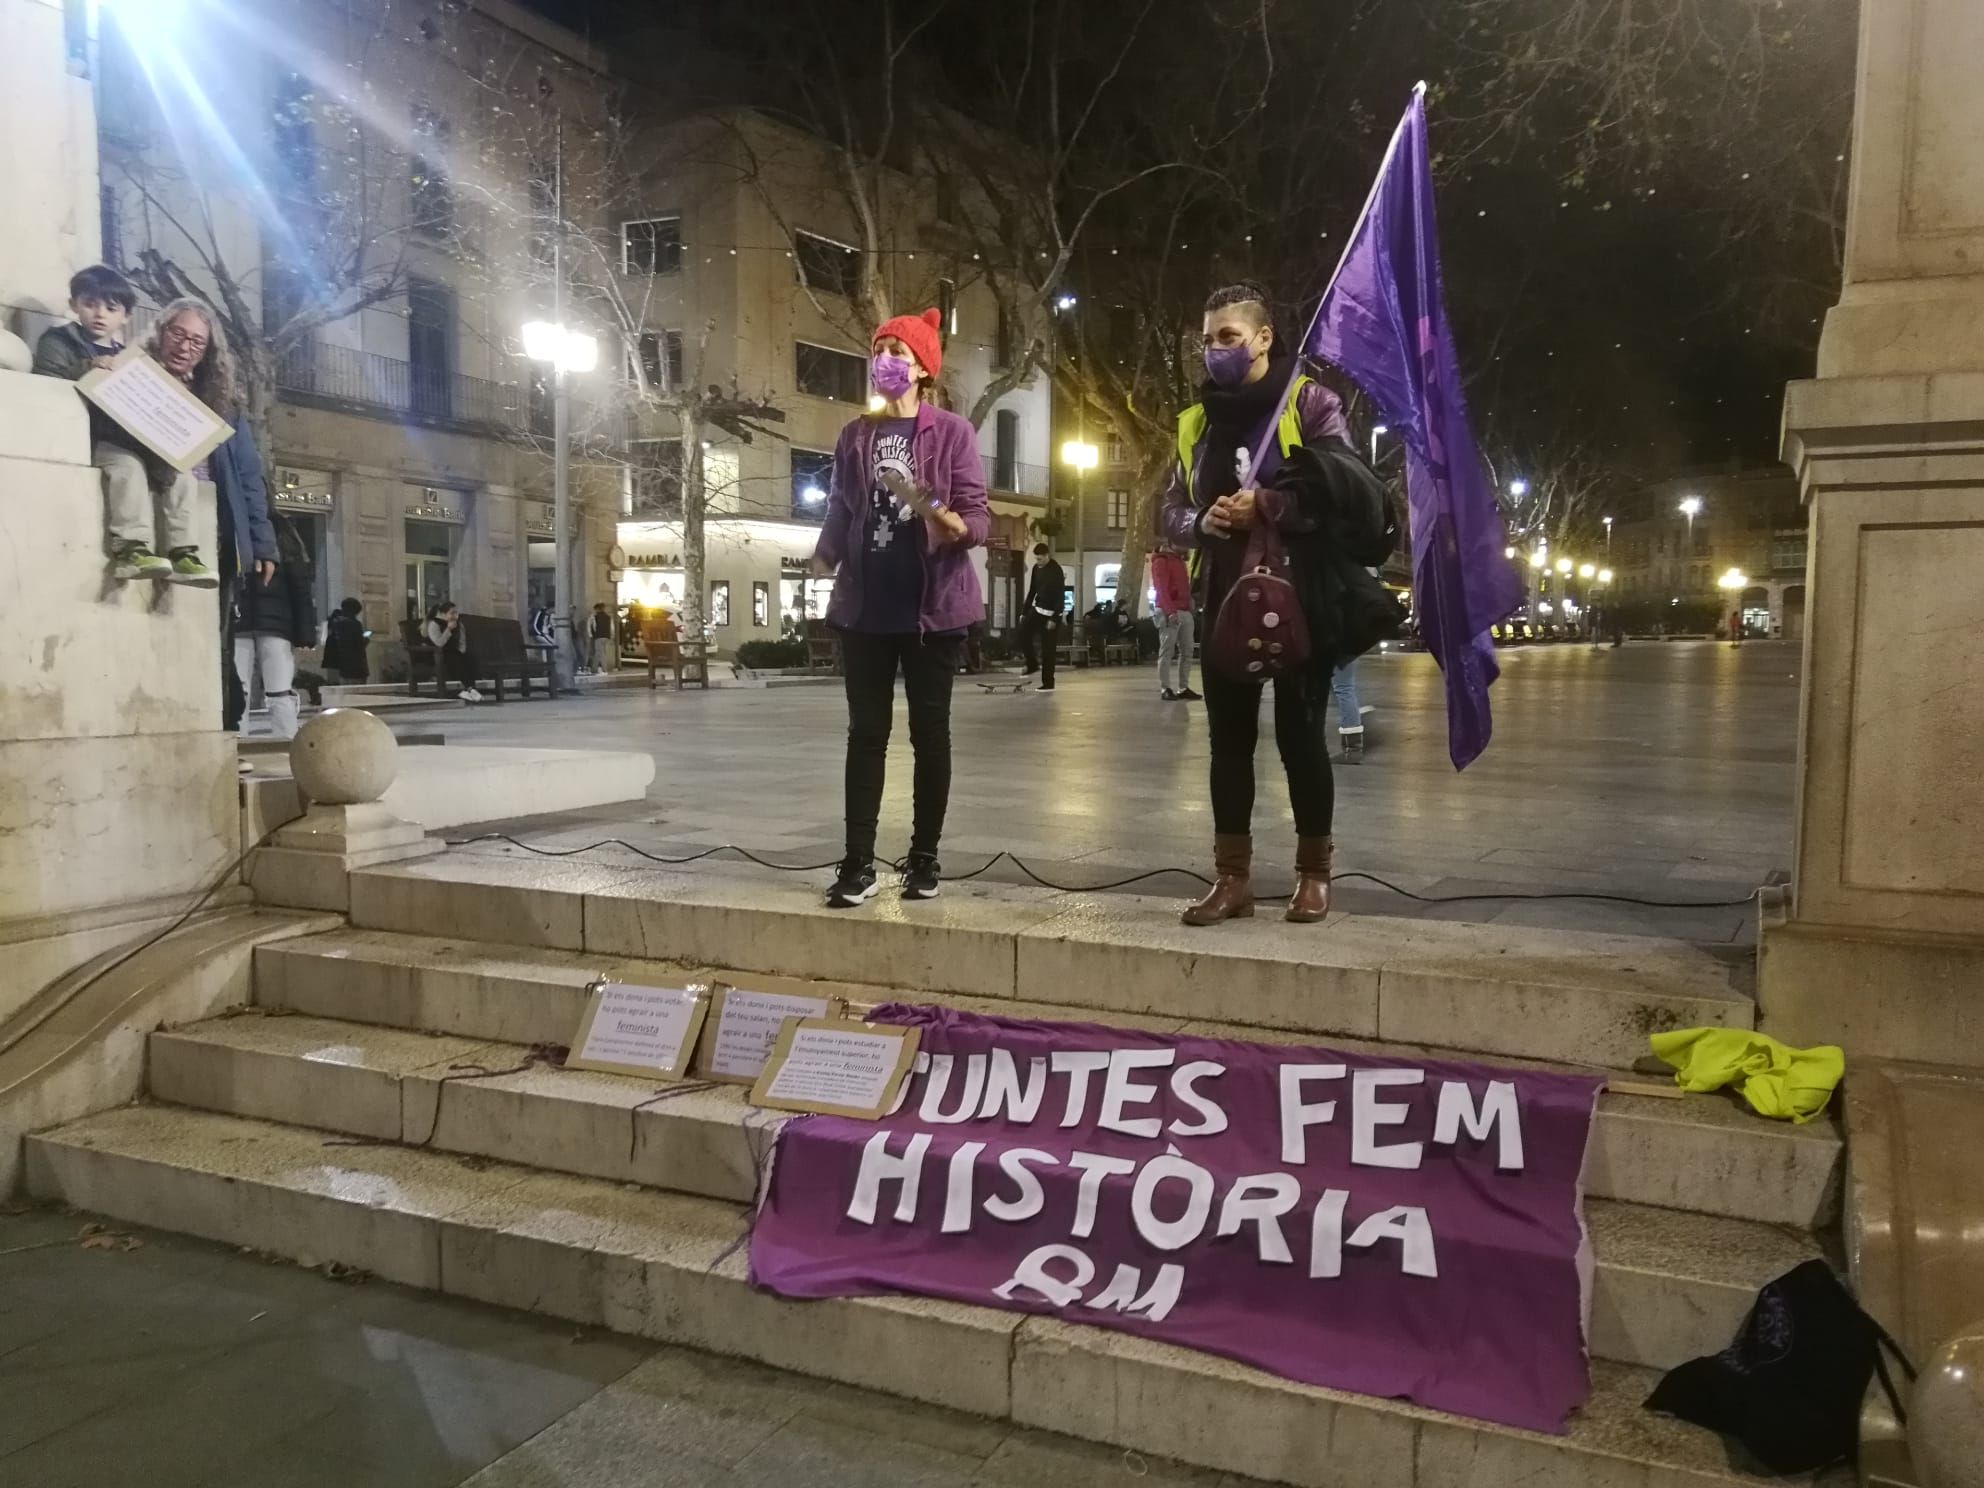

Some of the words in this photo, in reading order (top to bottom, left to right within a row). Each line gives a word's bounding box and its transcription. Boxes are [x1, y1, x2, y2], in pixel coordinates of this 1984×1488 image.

[876, 434, 909, 451] JUNTES
[444, 507, 465, 521] Bank
[629, 554, 681, 567] RAMBLA
[747, 1000, 764, 1009] dona
[725, 1009, 736, 1019] del
[615, 1019, 660, 1036] feminista
[838, 1038, 853, 1047] pots
[853, 1039, 880, 1048] estudiar
[843, 1061, 884, 1074] feminista
[1279, 1063, 1525, 1169] FEM
[846, 1131, 1439, 1278] HISTÒRIA
